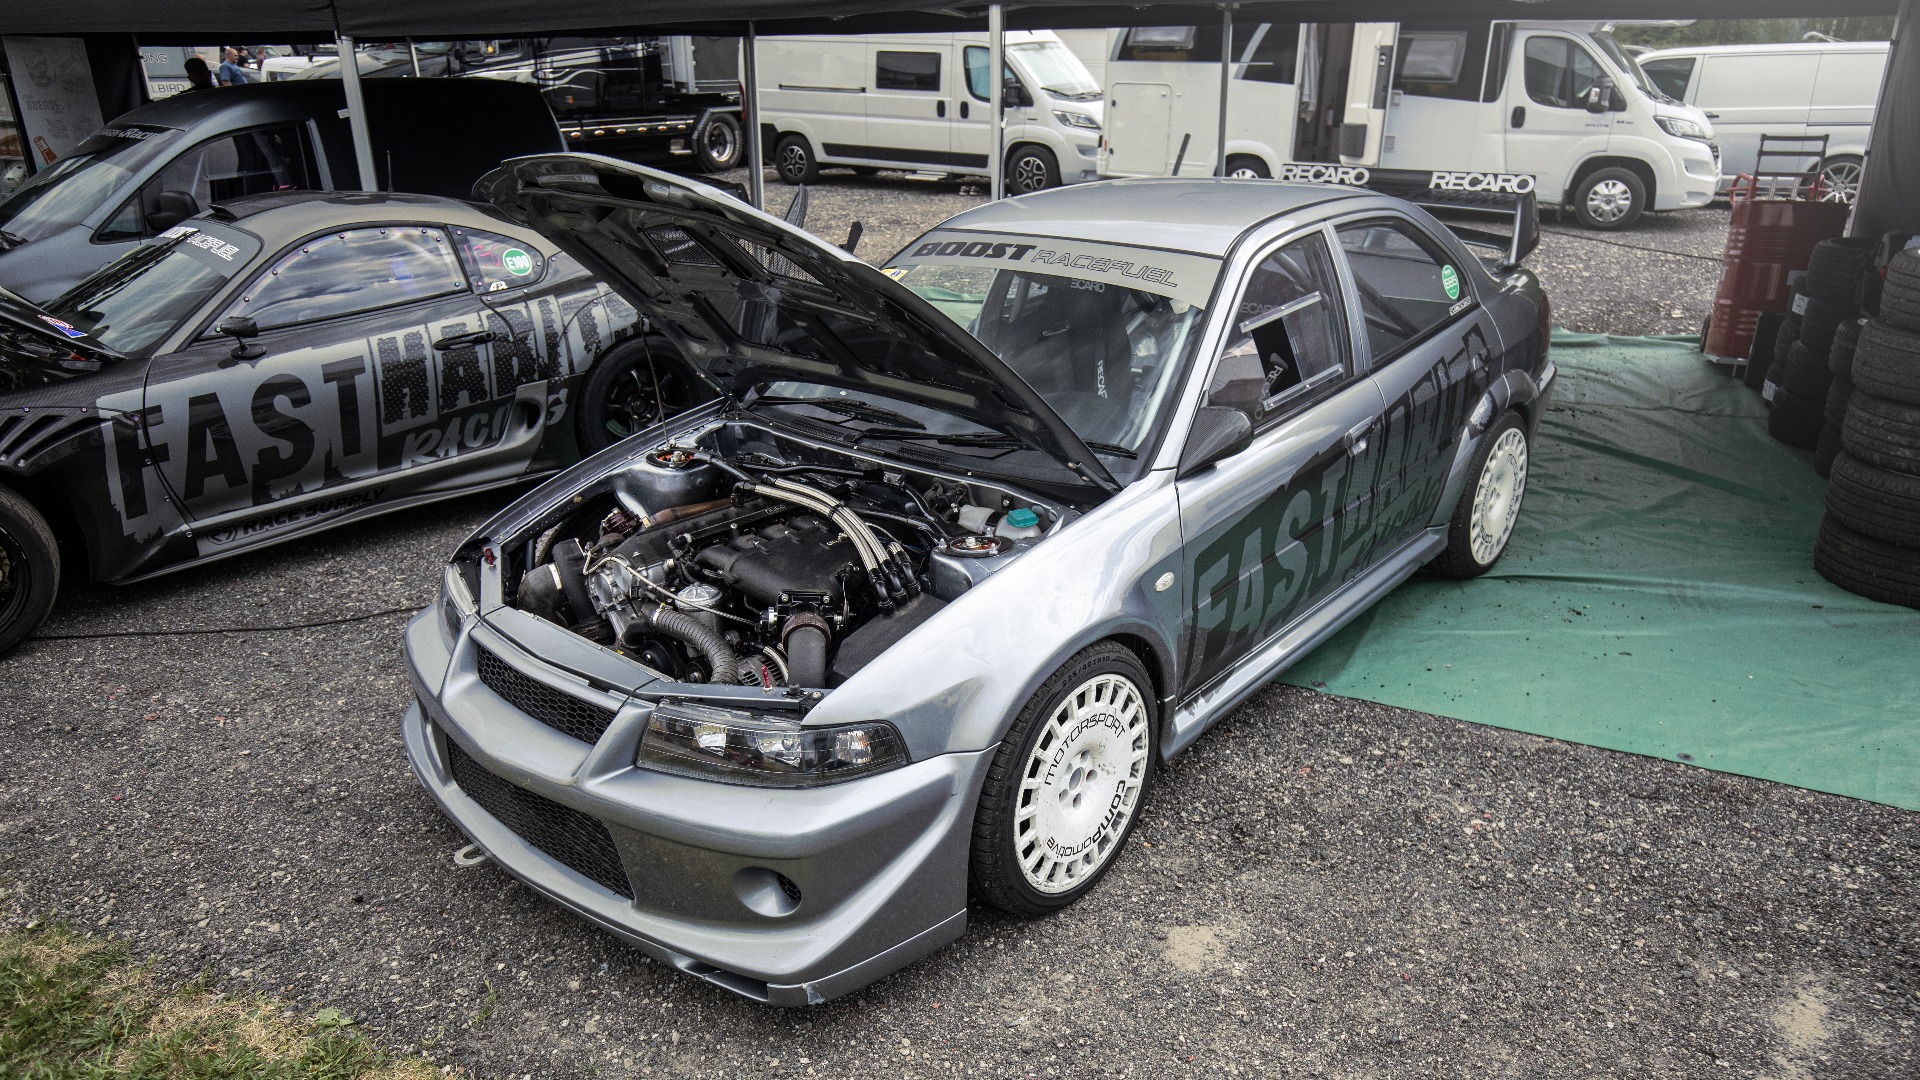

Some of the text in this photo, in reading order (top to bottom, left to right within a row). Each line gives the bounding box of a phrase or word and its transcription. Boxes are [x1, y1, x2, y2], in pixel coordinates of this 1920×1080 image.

[1280, 164, 1370, 186] RECARO
[1428, 171, 1535, 194] RECARO
[506, 255, 530, 270] E100
[911, 241, 1178, 288] BOOST RACEFUEL
[1071, 279, 1106, 293] ECARO
[1240, 302, 1273, 314] ECAR
[1097, 360, 1108, 399] RECAR
[110, 354, 367, 521] FAST
[400, 388, 569, 470] RACIG
[243, 507, 302, 535] RACE
[305, 485, 388, 518] SUPPLY
[1188, 465, 1347, 680] FAST
[1044, 713, 1126, 786] MOTORSPORT
